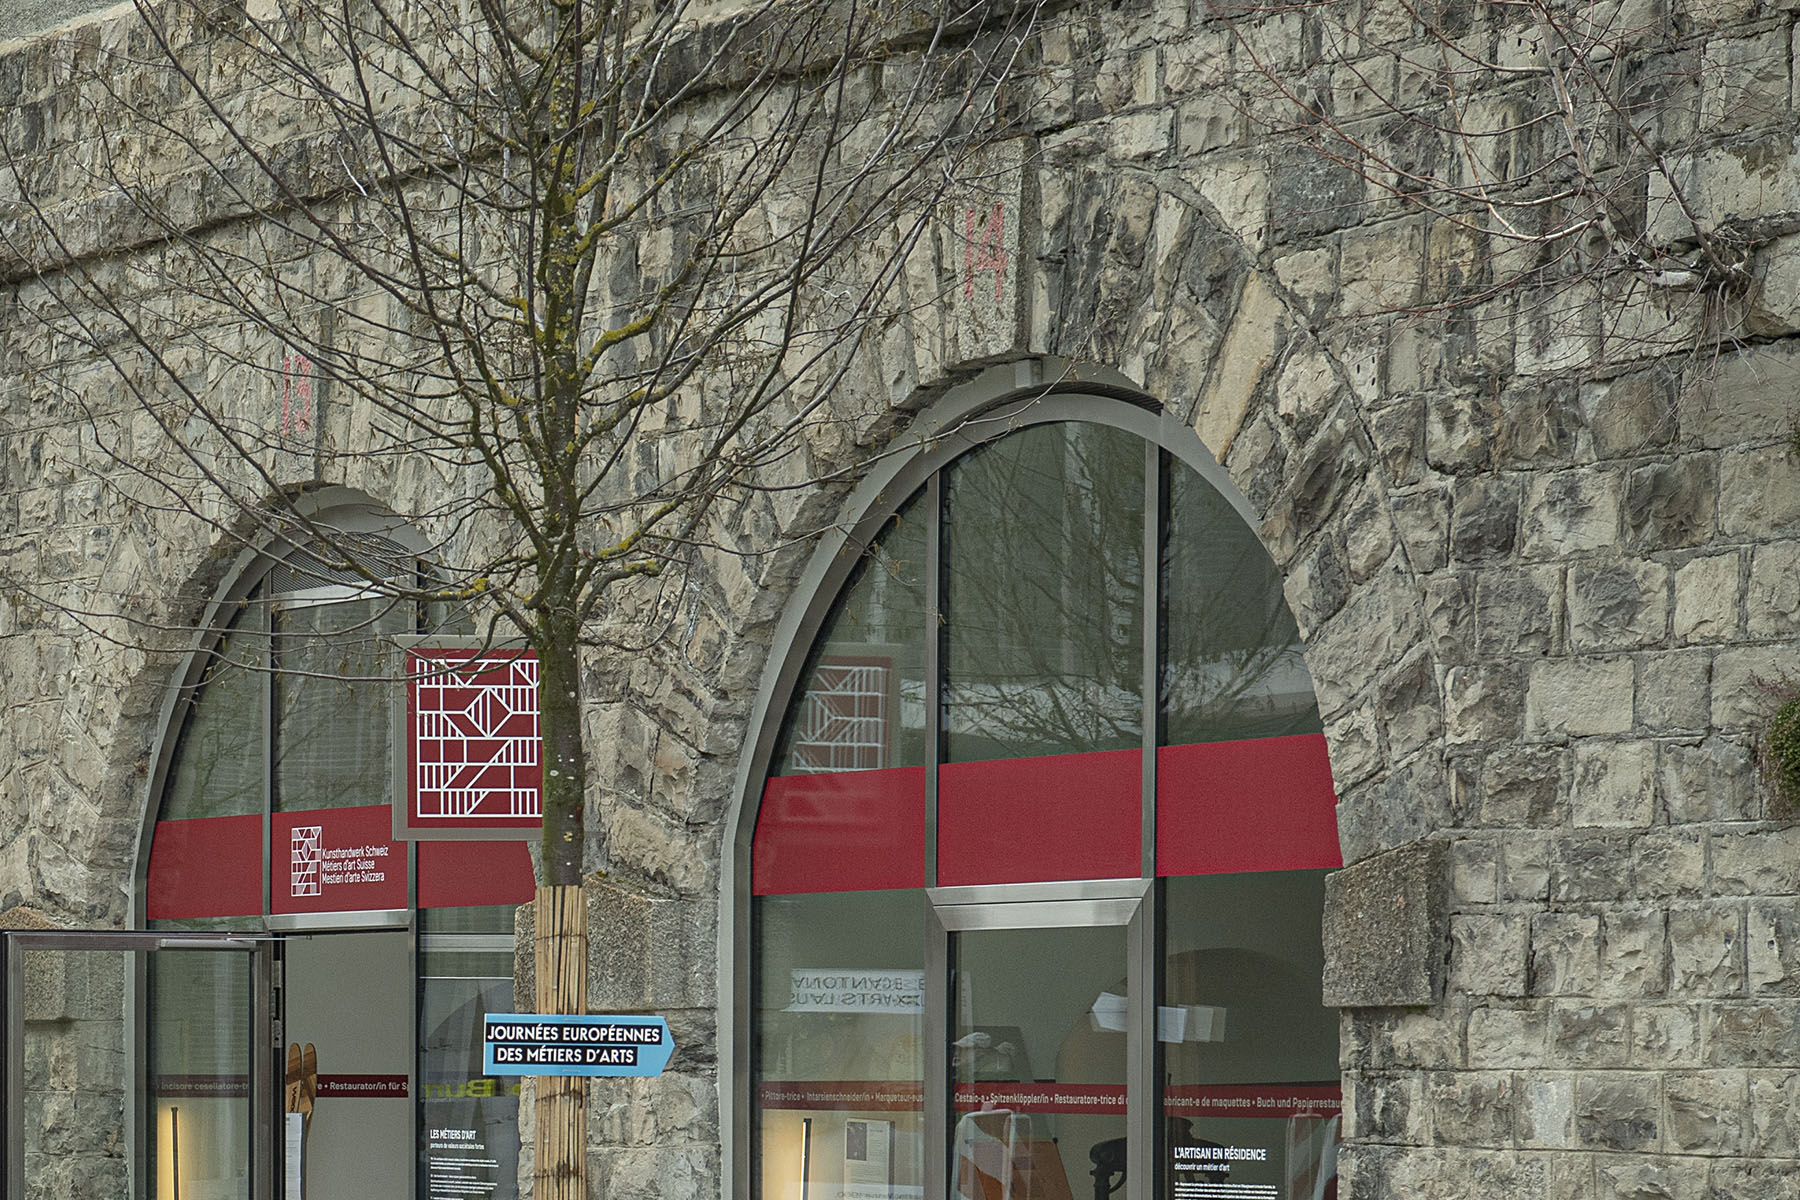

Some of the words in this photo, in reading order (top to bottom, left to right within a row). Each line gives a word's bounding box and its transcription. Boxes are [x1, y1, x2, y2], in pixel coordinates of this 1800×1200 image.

[964, 200, 1009, 302] 14
[322, 846, 364, 859] Kunsthandwerk
[365, 845, 388, 857] Schweiz
[322, 860, 342, 871] Métiers
[343, 860, 356, 870] d'art
[356, 859, 375, 870] Suisse
[322, 872, 343, 884] Mestieri
[344, 872, 360, 883] d'arte
[361, 871, 385, 882] Svizzera
[487, 1024, 558, 1041] JOURNÉES
[563, 1025, 660, 1042] EUROPÉENNES
[497, 1047, 523, 1062] DES
[526, 1045, 582, 1063] MÉTIERS
[586, 1048, 634, 1063] D'ARTS
[194, 1082, 249, 1090] cesellatore-tr
[330, 1081, 387, 1090] Restaurator/in
[389, 1082, 400, 1090] für
[875, 1092, 924, 1103] Marqueteur-eus
[990, 1092, 1049, 1106] Spitzenklöppler/in
[1164, 1096, 1200, 1106] abricant-e
[1202, 1096, 1210, 1107] de
[1212, 1097, 1251, 1109] maquettes
[1256, 1097, 1275, 1107] Buch
[1277, 1097, 1291, 1107] und
[1292, 1097, 1342, 1110] Papierrestau
[430, 1129, 439, 1139] LES
[440, 1127, 461, 1140] MÉTIERS
[462, 1130, 476, 1140] D'ART
[1175, 1147, 1211, 1159] L'ARTISAN
[1212, 1147, 1223, 1159] EN
[1224, 1145, 1267, 1160] RÉSIDENCE
